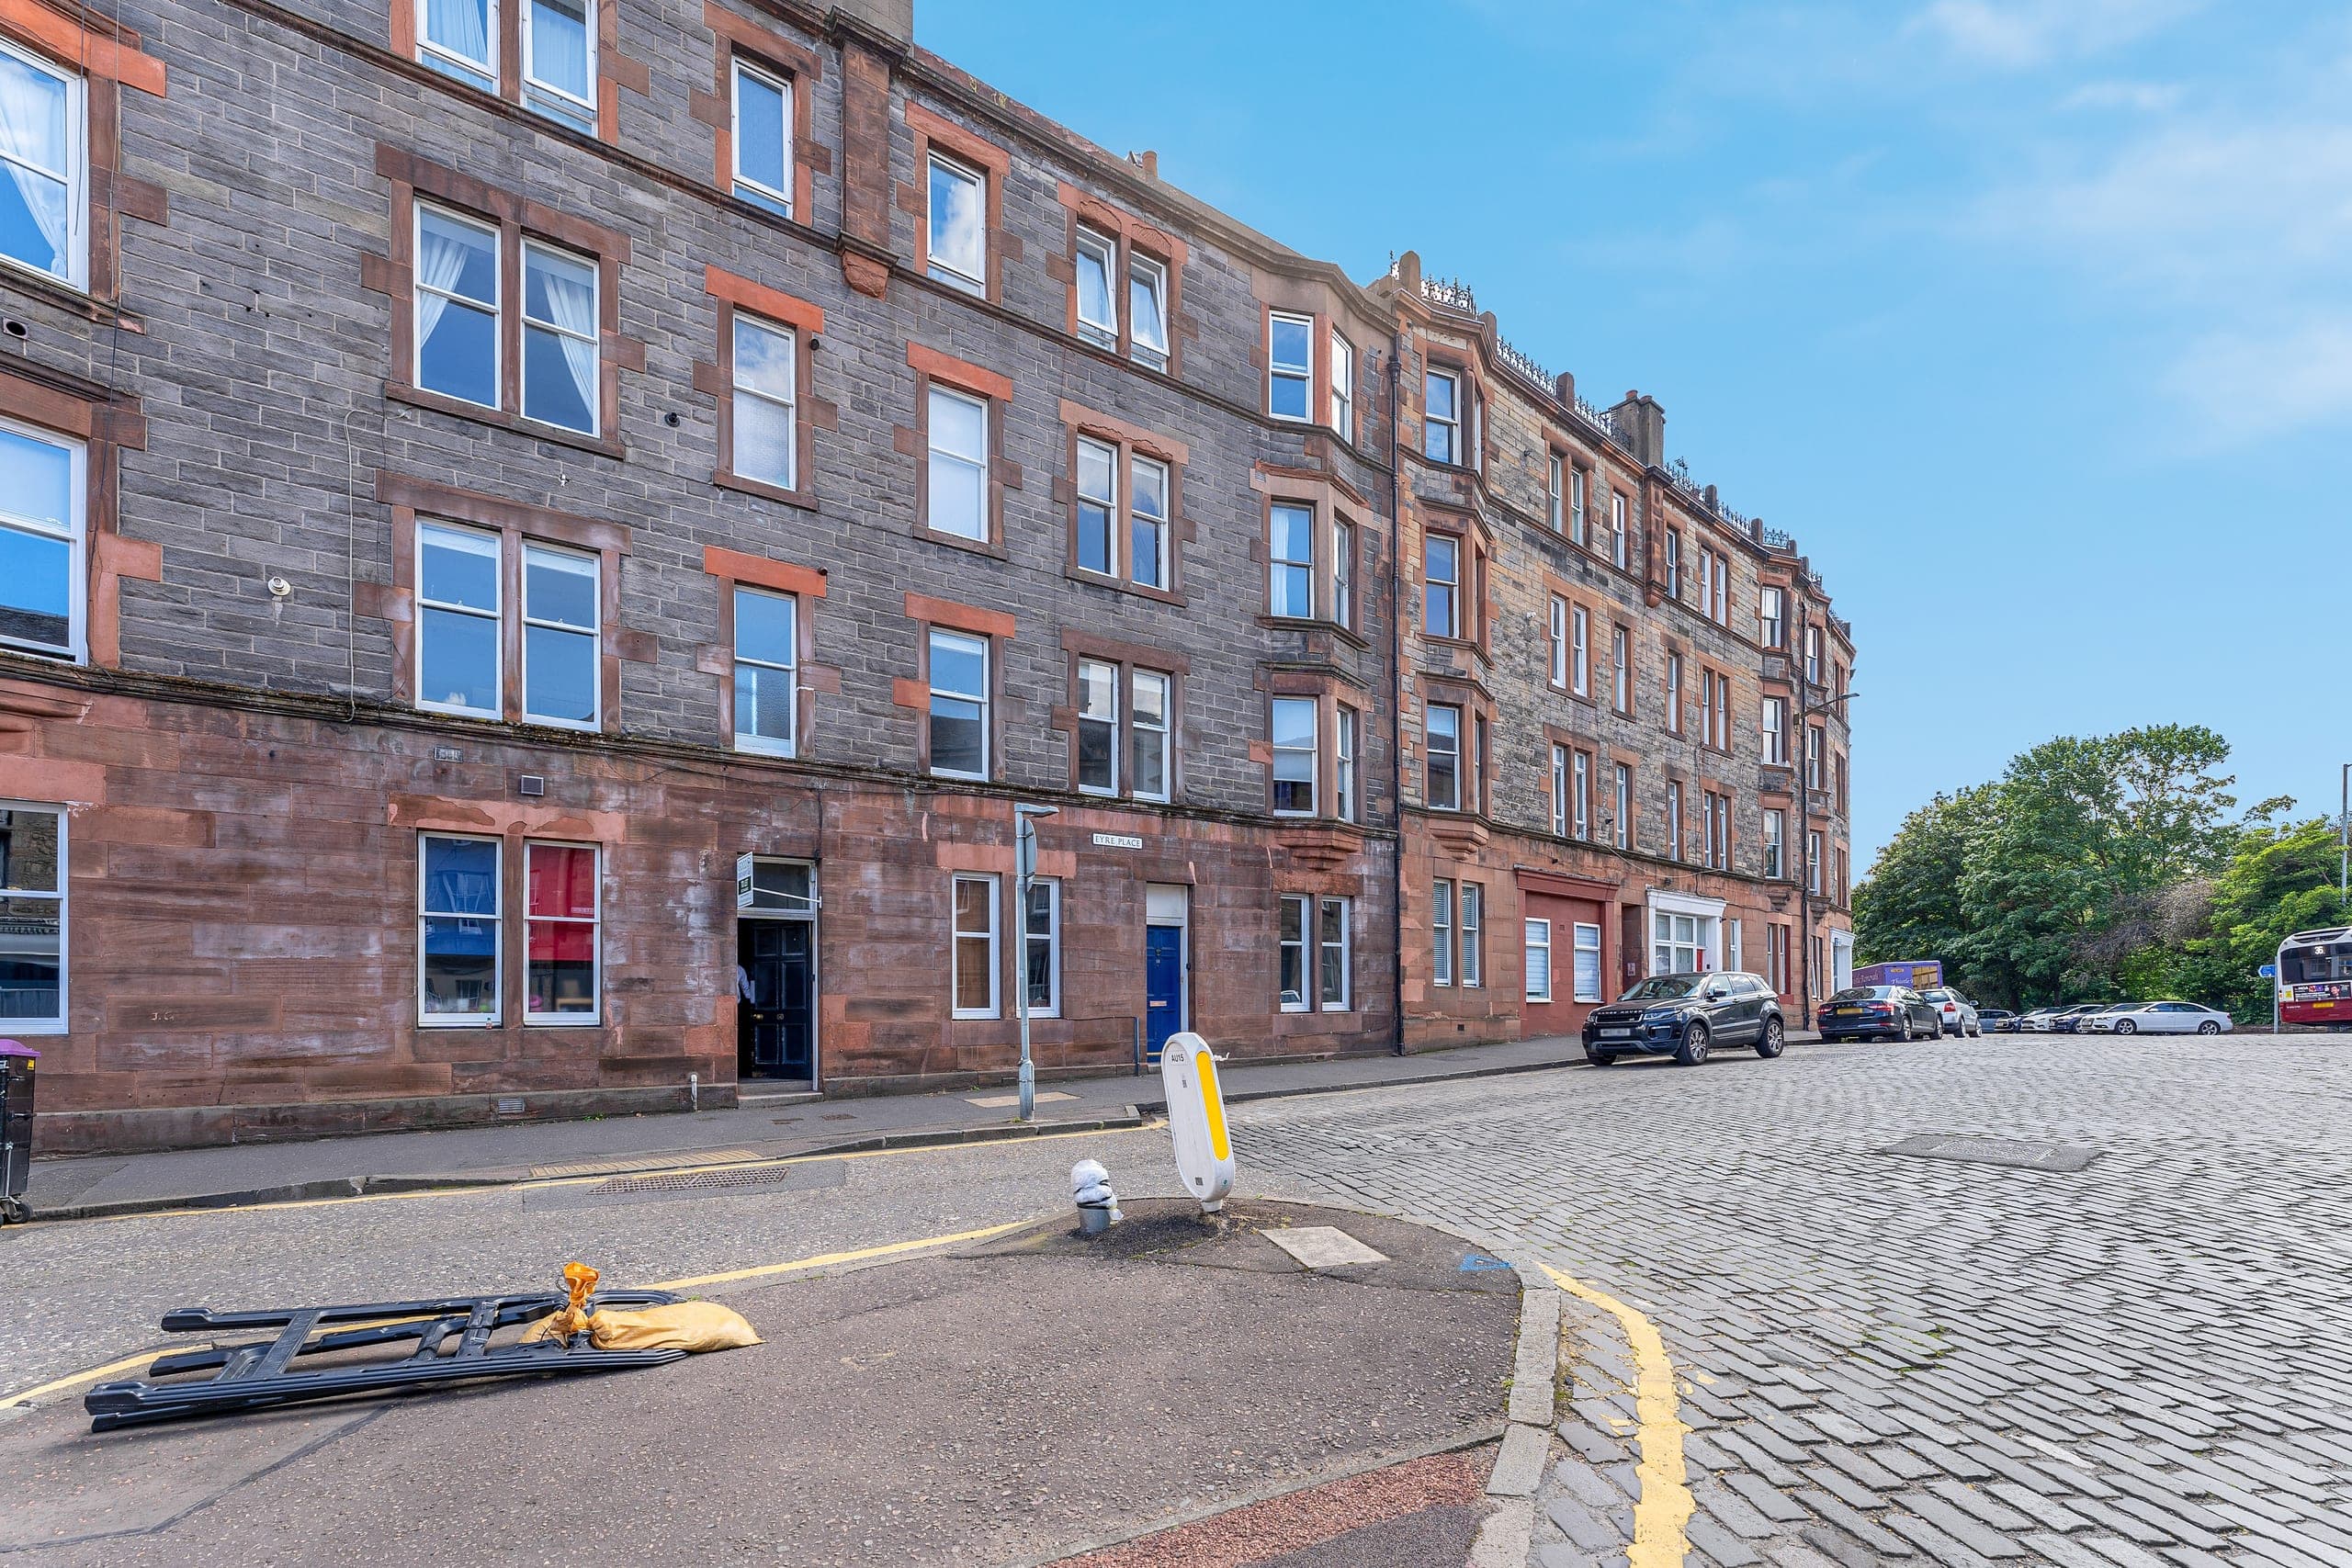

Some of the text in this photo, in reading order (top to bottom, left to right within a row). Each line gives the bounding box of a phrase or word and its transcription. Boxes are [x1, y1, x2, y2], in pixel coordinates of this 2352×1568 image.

[1095, 835, 1141, 847] EYRE PLACE
[1170, 1054, 1185, 1063] AU15
